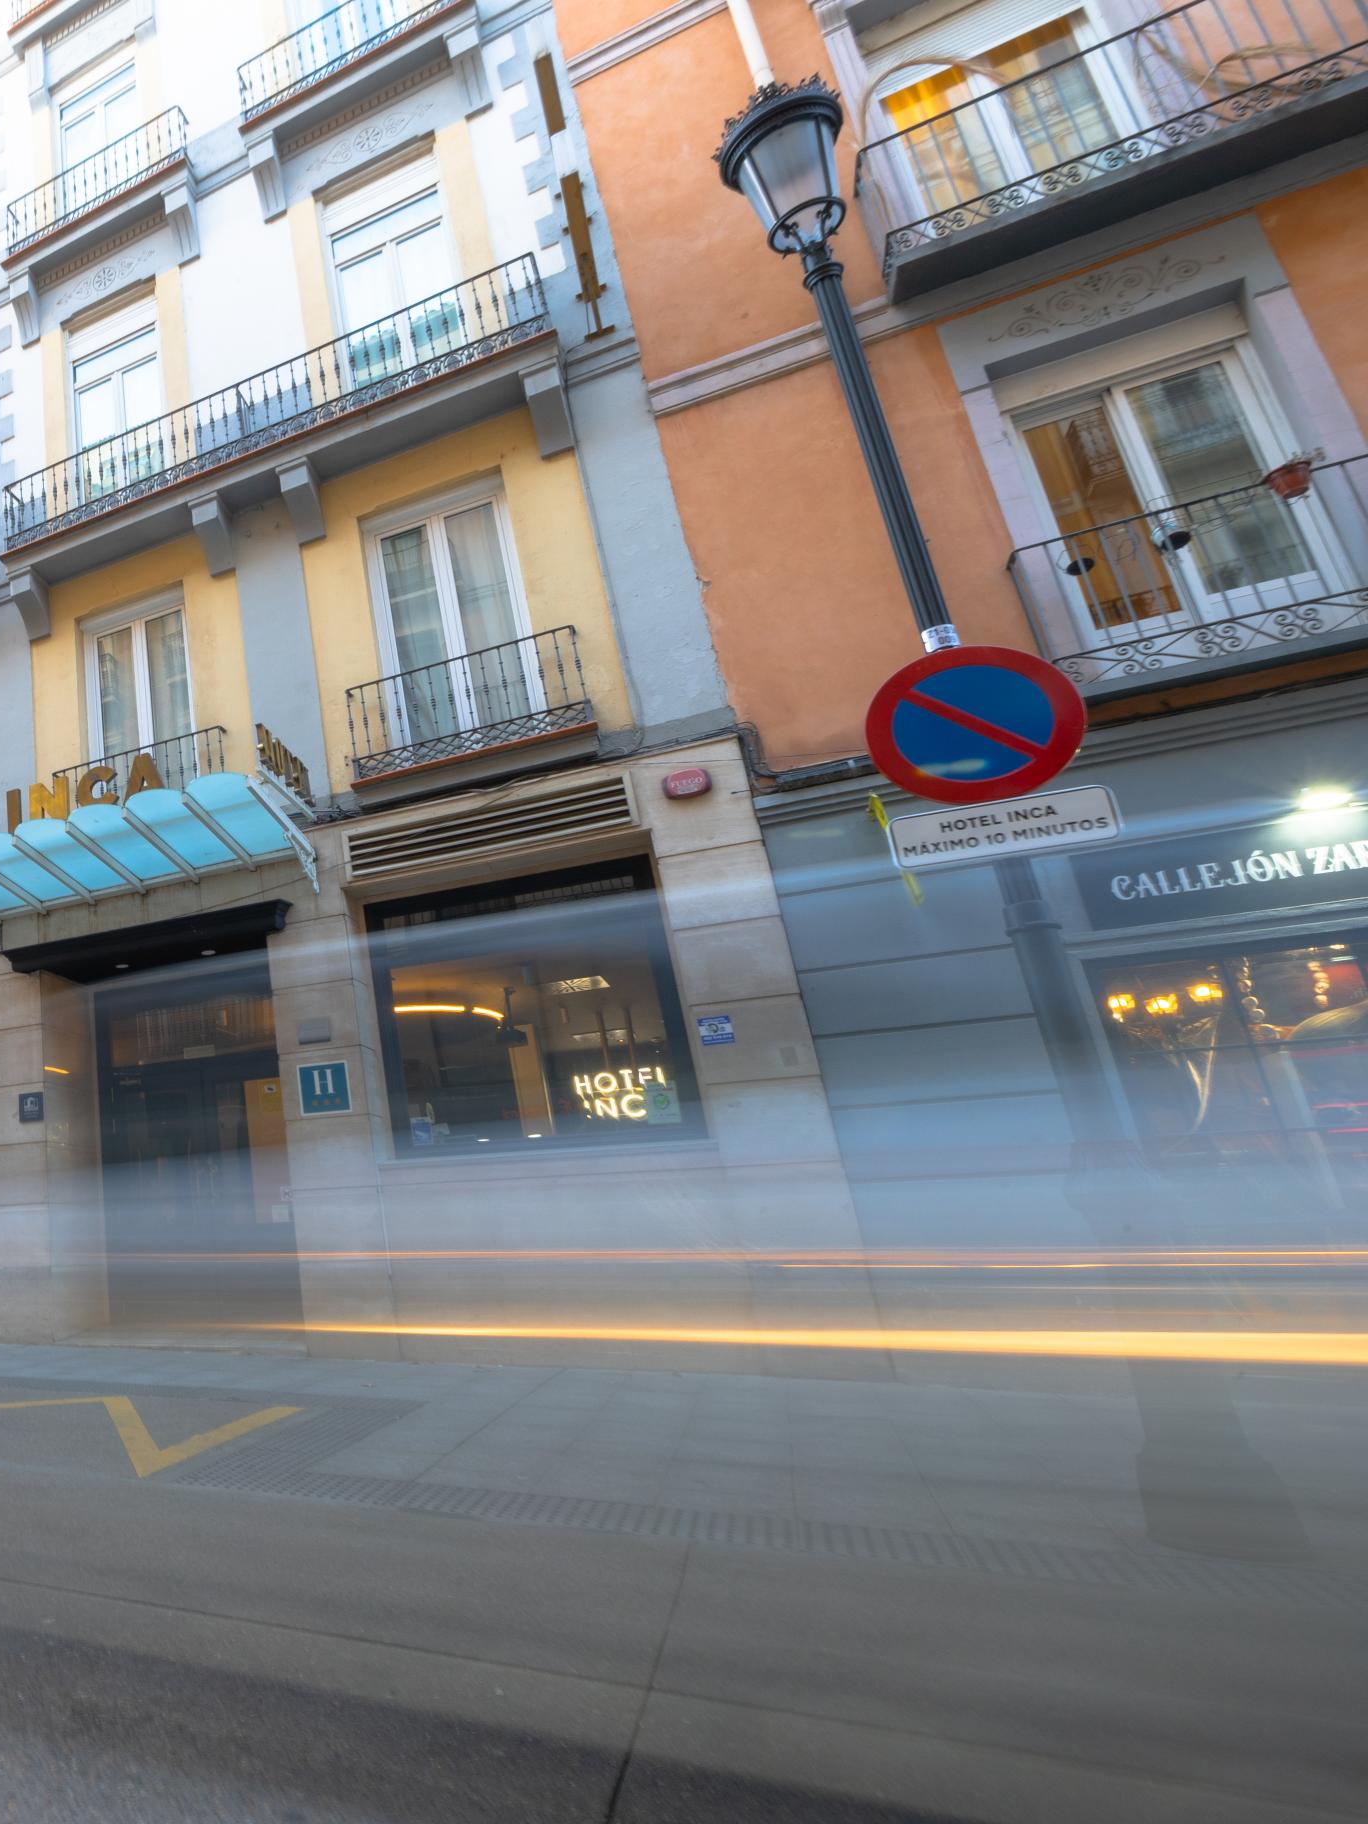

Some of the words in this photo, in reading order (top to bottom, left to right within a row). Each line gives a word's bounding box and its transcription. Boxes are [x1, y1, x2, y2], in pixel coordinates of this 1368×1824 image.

[6, 752, 166, 833] INCA
[903, 835, 980, 858] MÁXIMO
[985, 832, 1007, 846] 10
[1013, 817, 1110, 842] MINUTOS
[940, 814, 1002, 833] HOTEL
[1007, 804, 1059, 823] INCA
[1110, 849, 1304, 901] CALLEJÓN
[313, 1068, 336, 1096] H
